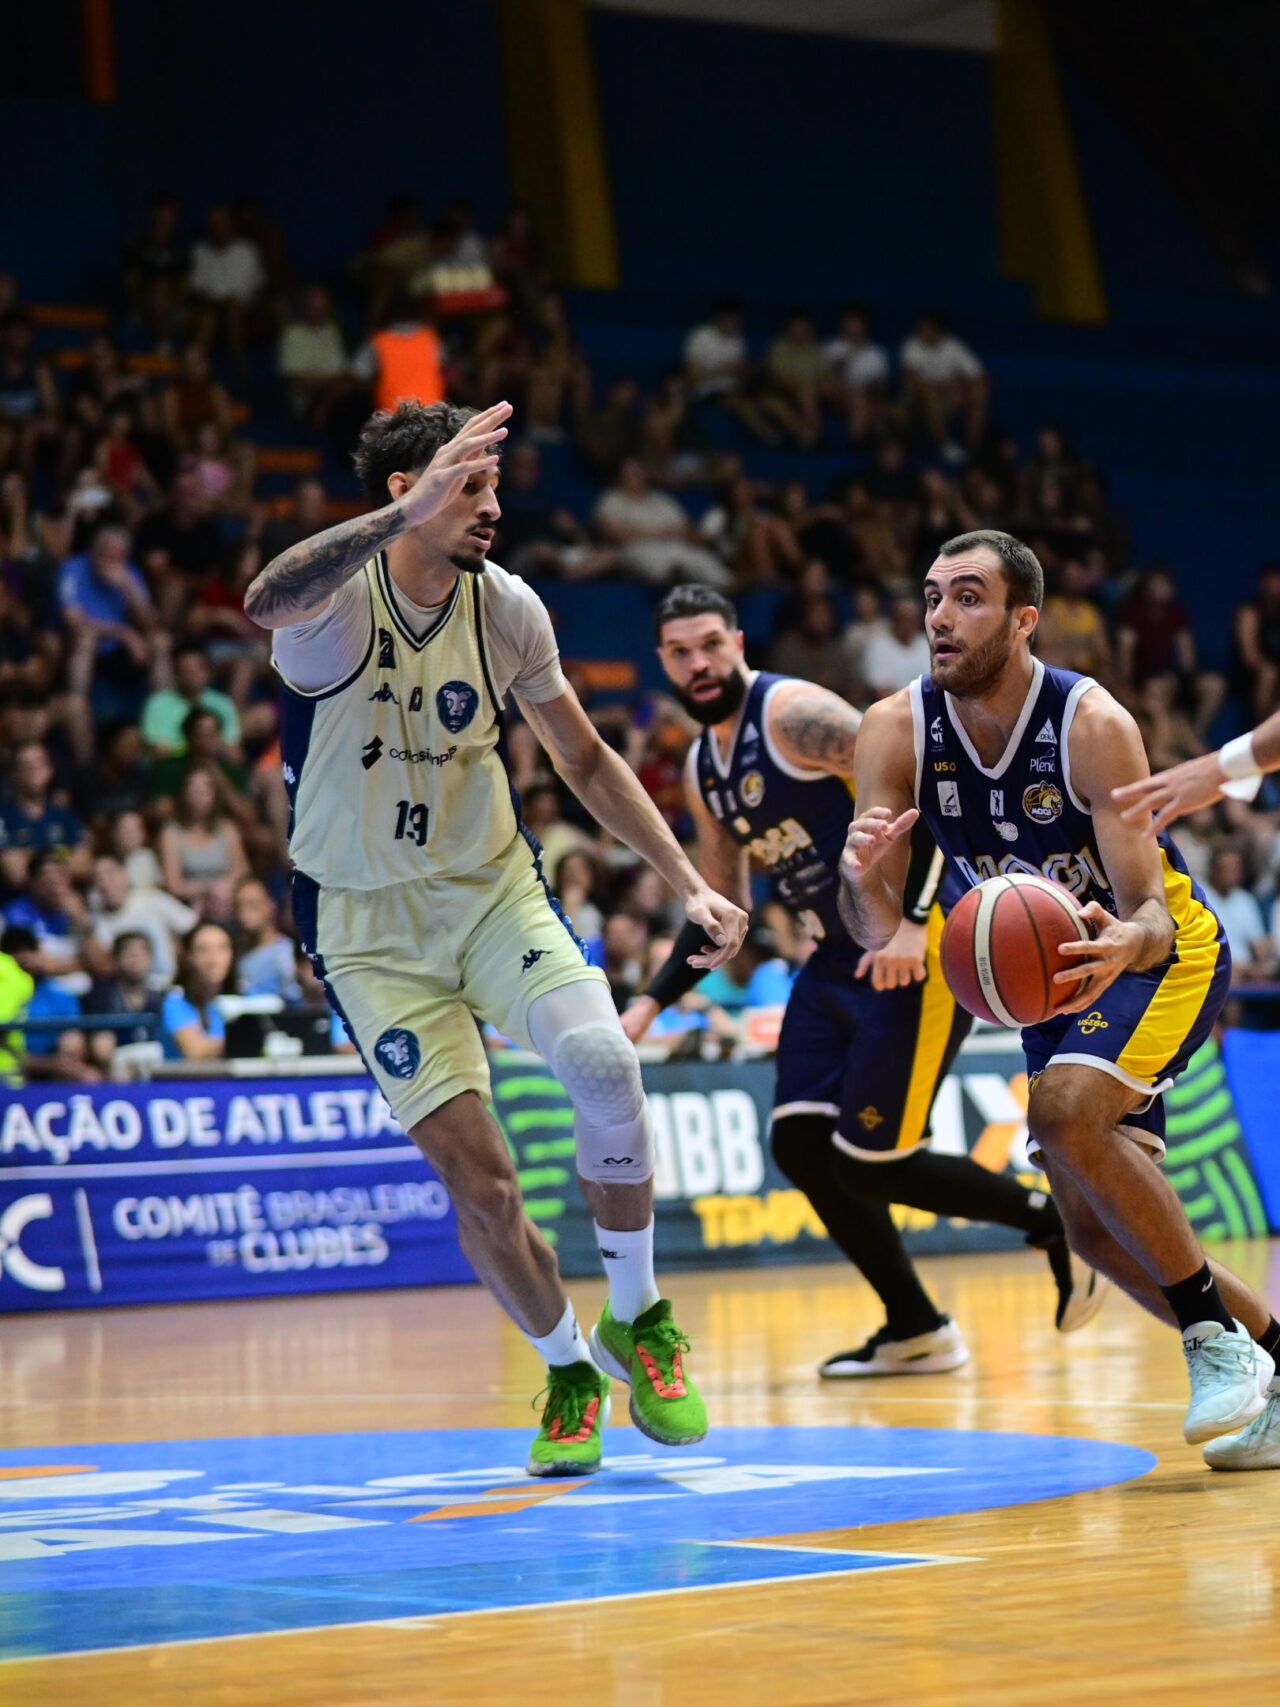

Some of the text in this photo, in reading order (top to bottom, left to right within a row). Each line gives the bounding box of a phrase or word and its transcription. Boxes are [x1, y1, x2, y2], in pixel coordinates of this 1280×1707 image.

[394, 800, 429, 847] 19
[1, 1089, 406, 1165] AÇÃO DE ATLETA
[113, 1181, 450, 1241] COMITÊ BRASILEIRO
[238, 1222, 389, 1274] CLUBES
